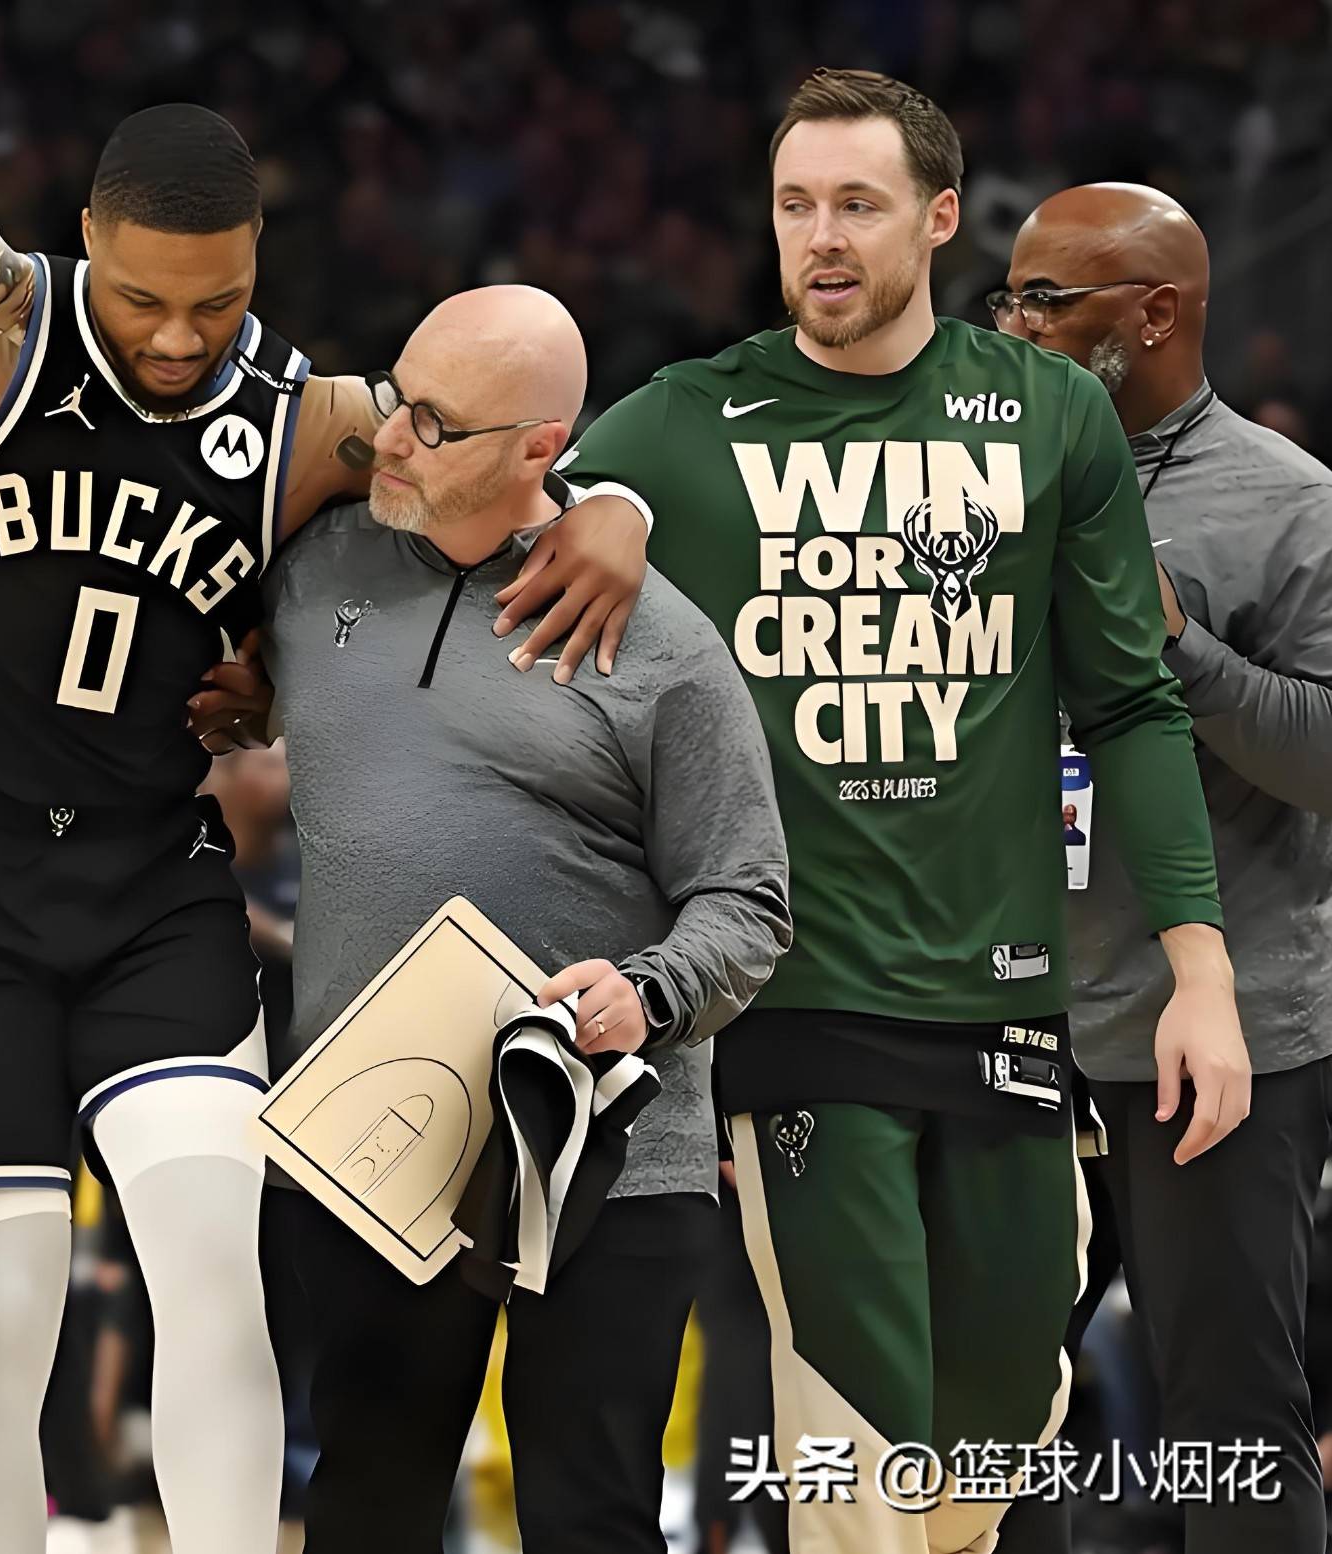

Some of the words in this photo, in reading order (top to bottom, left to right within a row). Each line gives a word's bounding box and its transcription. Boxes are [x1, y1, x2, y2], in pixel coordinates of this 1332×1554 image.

[731, 440, 1025, 533] WIN
[759, 535, 908, 591] FOR
[57, 586, 140, 714] 0
[734, 594, 1015, 677] CREAM
[794, 680, 971, 765] CITY
